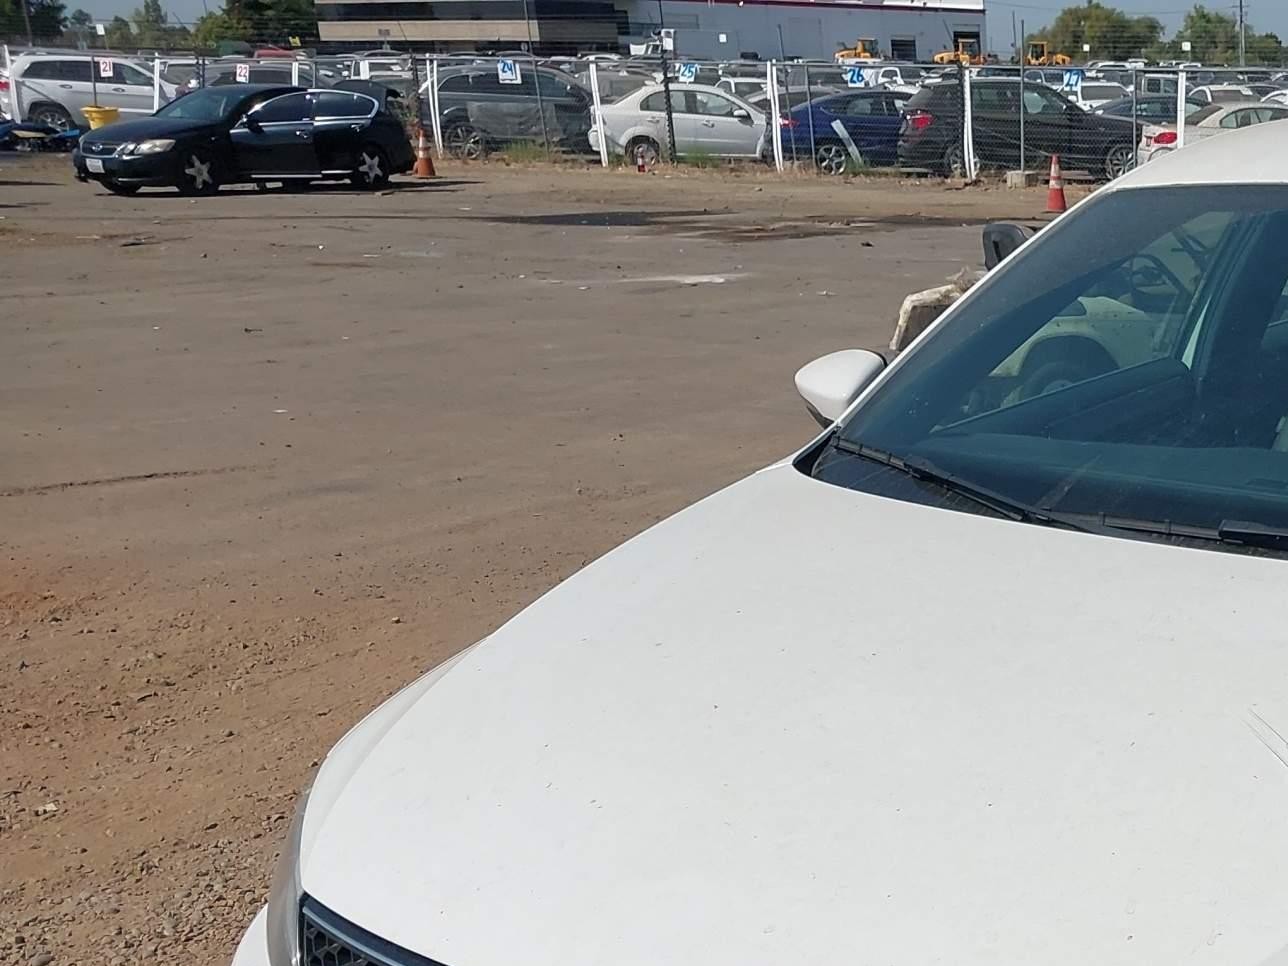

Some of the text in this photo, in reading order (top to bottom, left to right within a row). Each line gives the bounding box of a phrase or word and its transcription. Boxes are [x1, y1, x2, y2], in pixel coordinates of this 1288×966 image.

[101, 61, 112, 73] 21
[238, 65, 248, 78] 22
[501, 61, 514, 75] 24
[681, 64, 693, 78] 25
[847, 67, 865, 83] 26
[1064, 71, 1081, 86] 27
